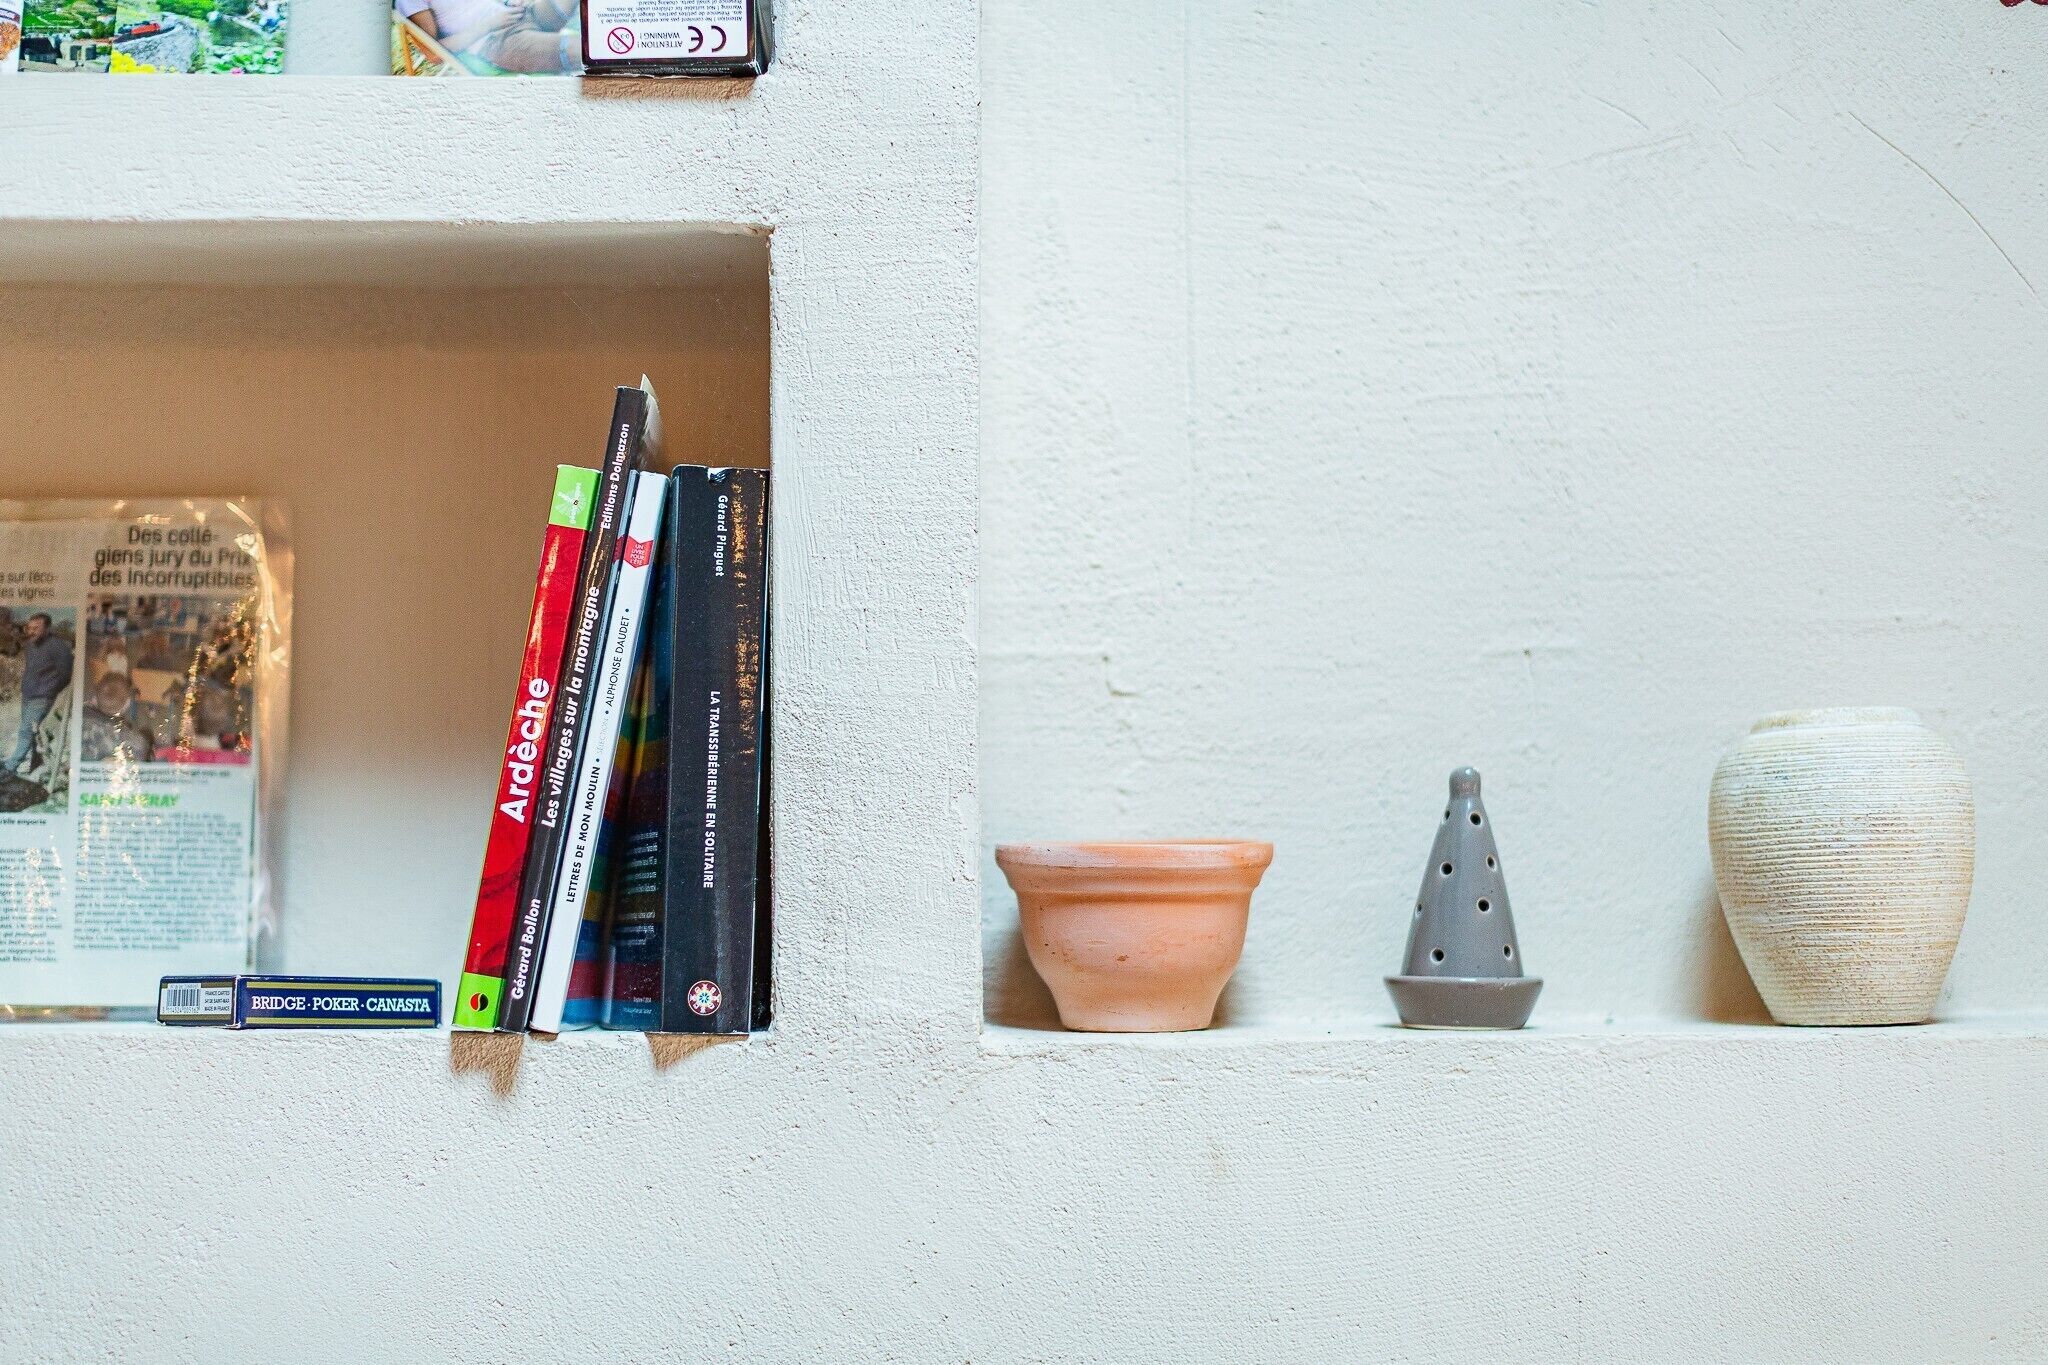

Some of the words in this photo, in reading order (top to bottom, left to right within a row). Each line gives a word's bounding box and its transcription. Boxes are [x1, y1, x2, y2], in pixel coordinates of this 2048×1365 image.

[610, 424, 630, 482] Dolmazon
[717, 495, 728, 533] Gérard
[128, 526, 162, 545] Des
[95, 550, 144, 570] giens
[148, 550, 184, 570] jury
[189, 549, 213, 566] du
[714, 536, 727, 577] Pinguet
[89, 566, 121, 586] des
[572, 586, 600, 674] montagne
[605, 656, 623, 707] ALPHONSE
[615, 615, 630, 653] DAUDET
[566, 678, 582, 695] la
[710, 691, 721, 704] LA
[564, 696, 580, 726] sur
[500, 678, 550, 823] Ardèche
[549, 728, 574, 796] villages
[706, 708, 720, 810] TRANSSIBÉRIENNE
[584, 766, 600, 811] MOULIN
[542, 799, 559, 828] Les
[579, 815, 591, 842] MON
[706, 813, 717, 827] EN
[575, 844, 585, 858] DE
[703, 831, 717, 889] SOLITAIRE
[566, 860, 582, 903] LETTRES
[511, 945, 532, 999] Gérard
[522, 898, 541, 945] Bollon
[251, 996, 307, 1011] BRIDGE
[312, 996, 360, 1011] POKER
[365, 997, 432, 1012] CANASTA
